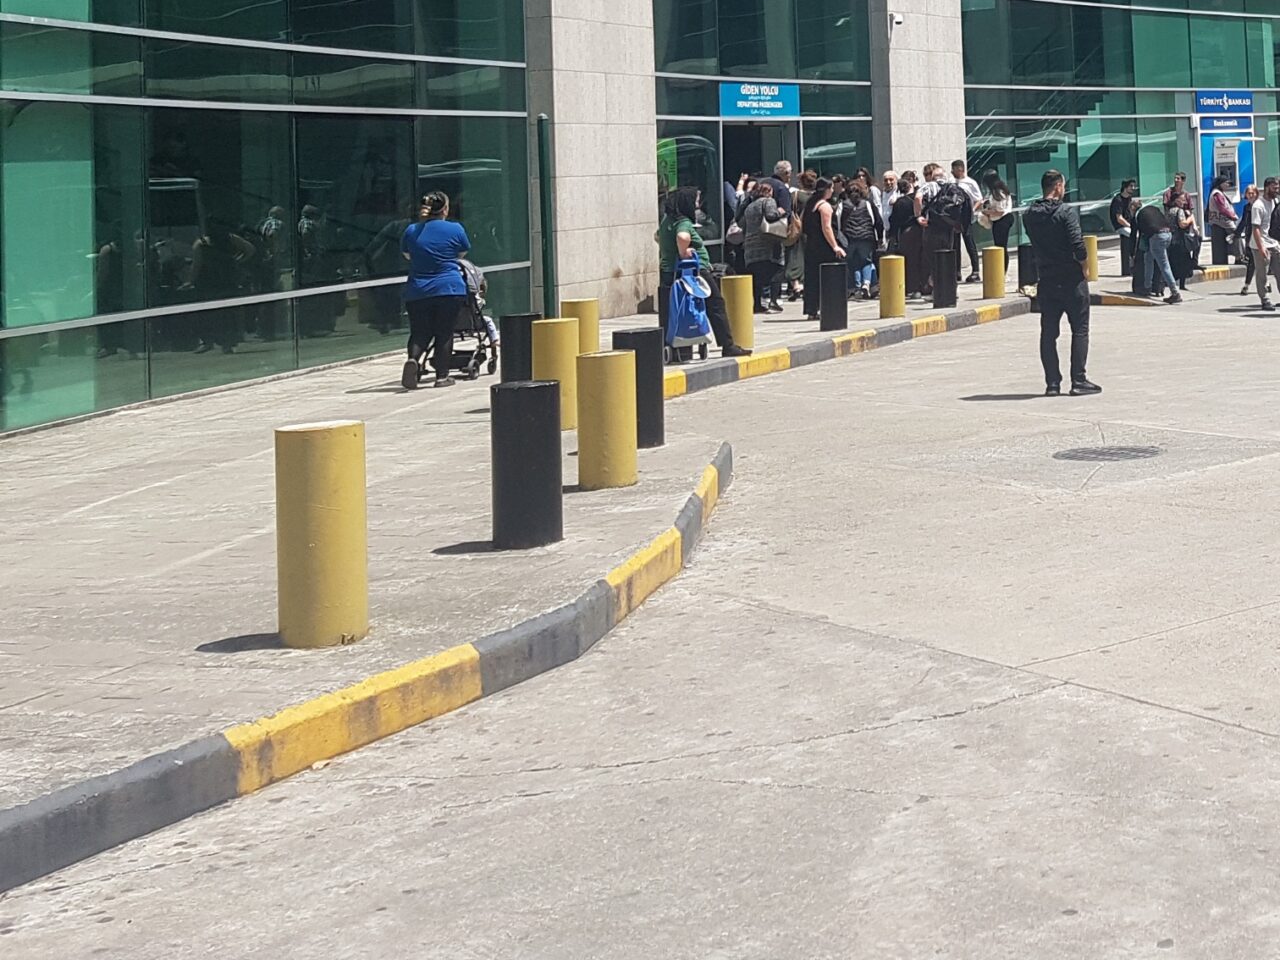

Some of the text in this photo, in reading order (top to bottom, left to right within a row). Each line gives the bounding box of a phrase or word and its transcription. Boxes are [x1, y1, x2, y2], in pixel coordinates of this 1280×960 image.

[741, 84, 779, 95] GİDEN YOLCU
[1200, 96, 1223, 106] TÜRKİYE
[1228, 98, 1251, 106] BANKASI
